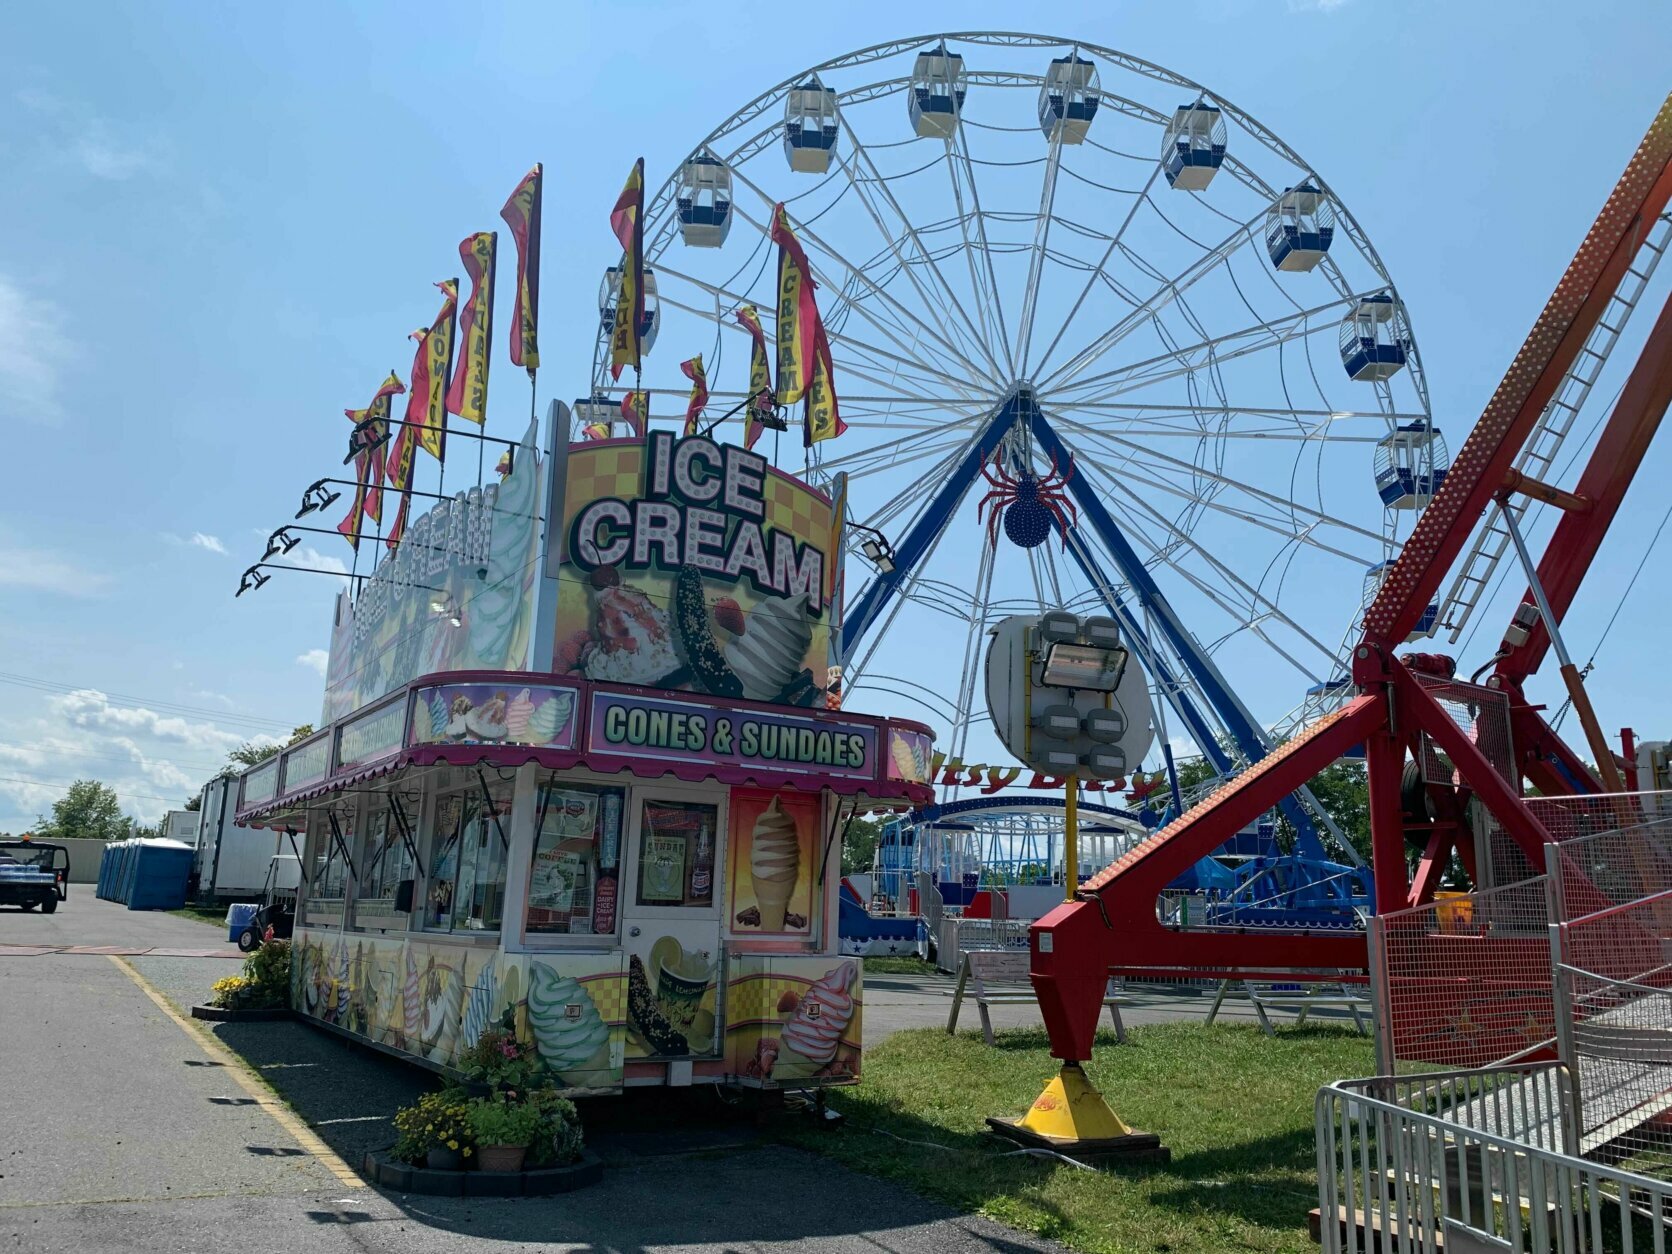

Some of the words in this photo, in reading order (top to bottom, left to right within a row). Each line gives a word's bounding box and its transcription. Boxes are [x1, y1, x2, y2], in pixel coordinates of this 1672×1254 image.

[779, 274, 799, 393] CREAM
[652, 432, 767, 517] ICE
[577, 500, 823, 612] CREAM
[604, 704, 706, 751] CONES
[712, 716, 734, 755] &
[740, 720, 865, 769] SUNDAES
[931, 750, 1021, 795] Itsy
[538, 852, 577, 865] COFFEE
